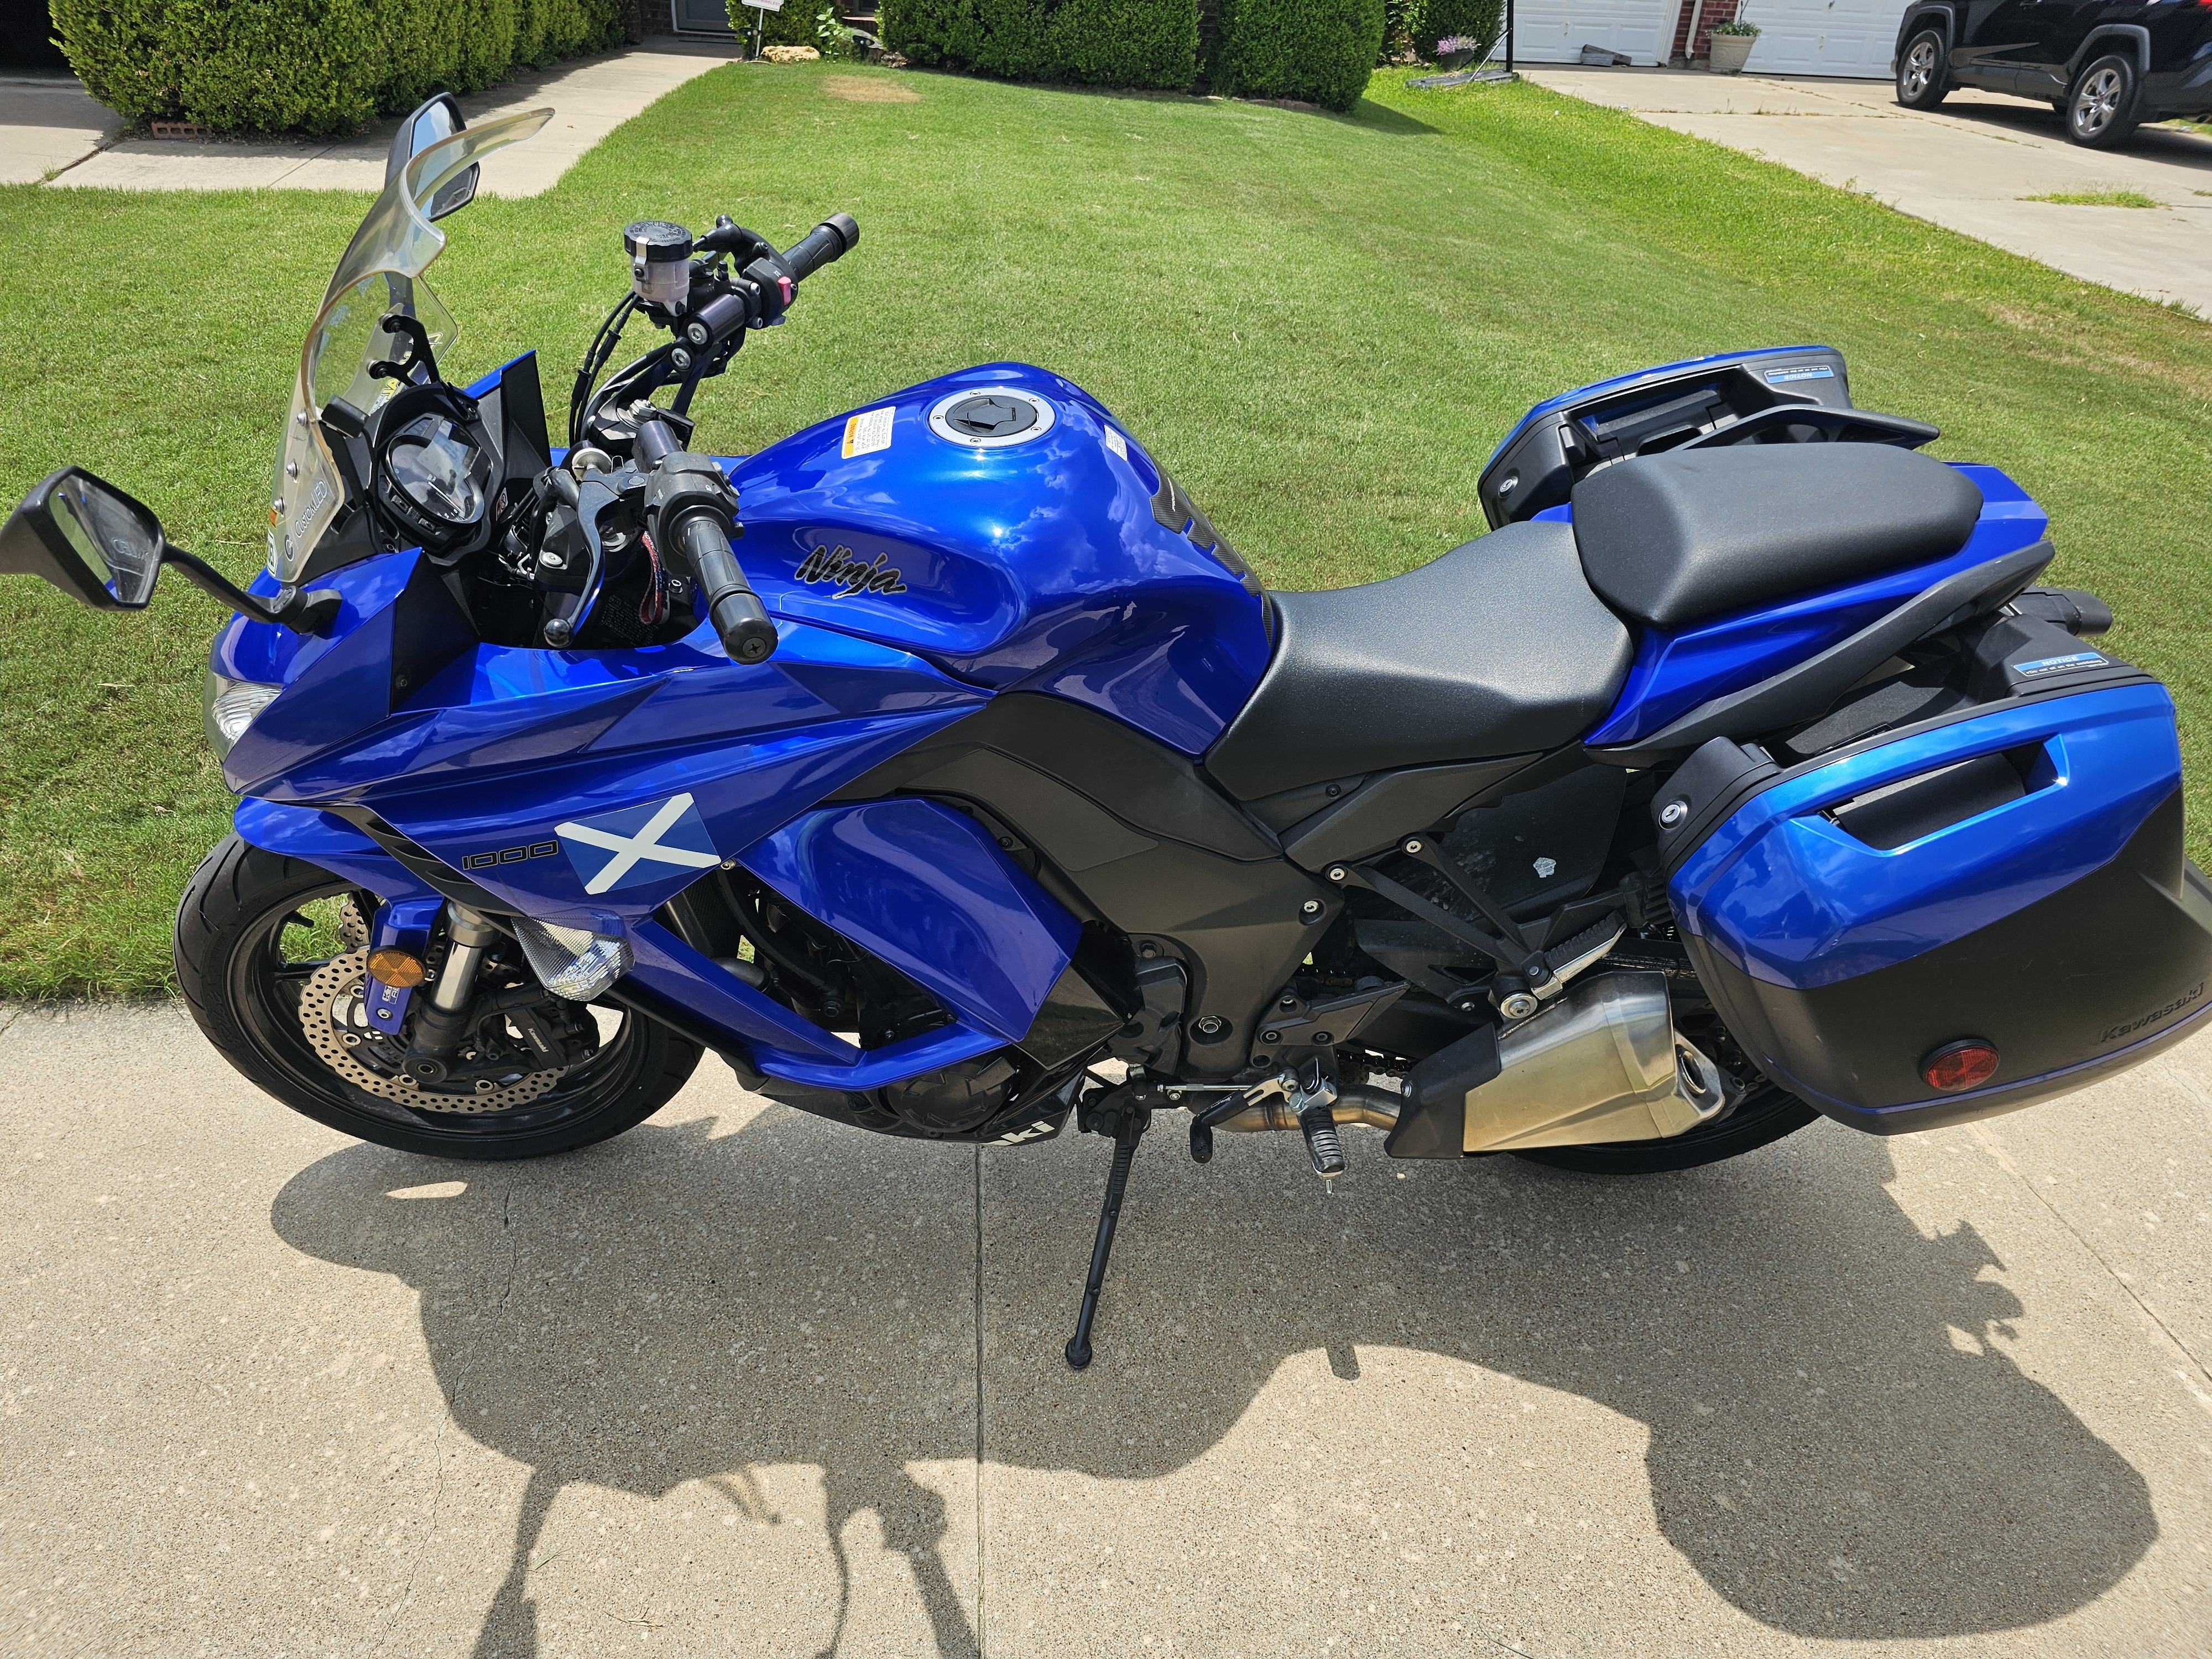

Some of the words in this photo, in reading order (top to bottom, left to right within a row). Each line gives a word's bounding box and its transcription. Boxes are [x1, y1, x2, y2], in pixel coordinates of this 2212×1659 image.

[794, 545, 907, 599] Ninja
[2041, 656, 2079, 666] NOTICE
[462, 840, 559, 870] 1000
[2100, 982, 2204, 1042] Kawasaki
